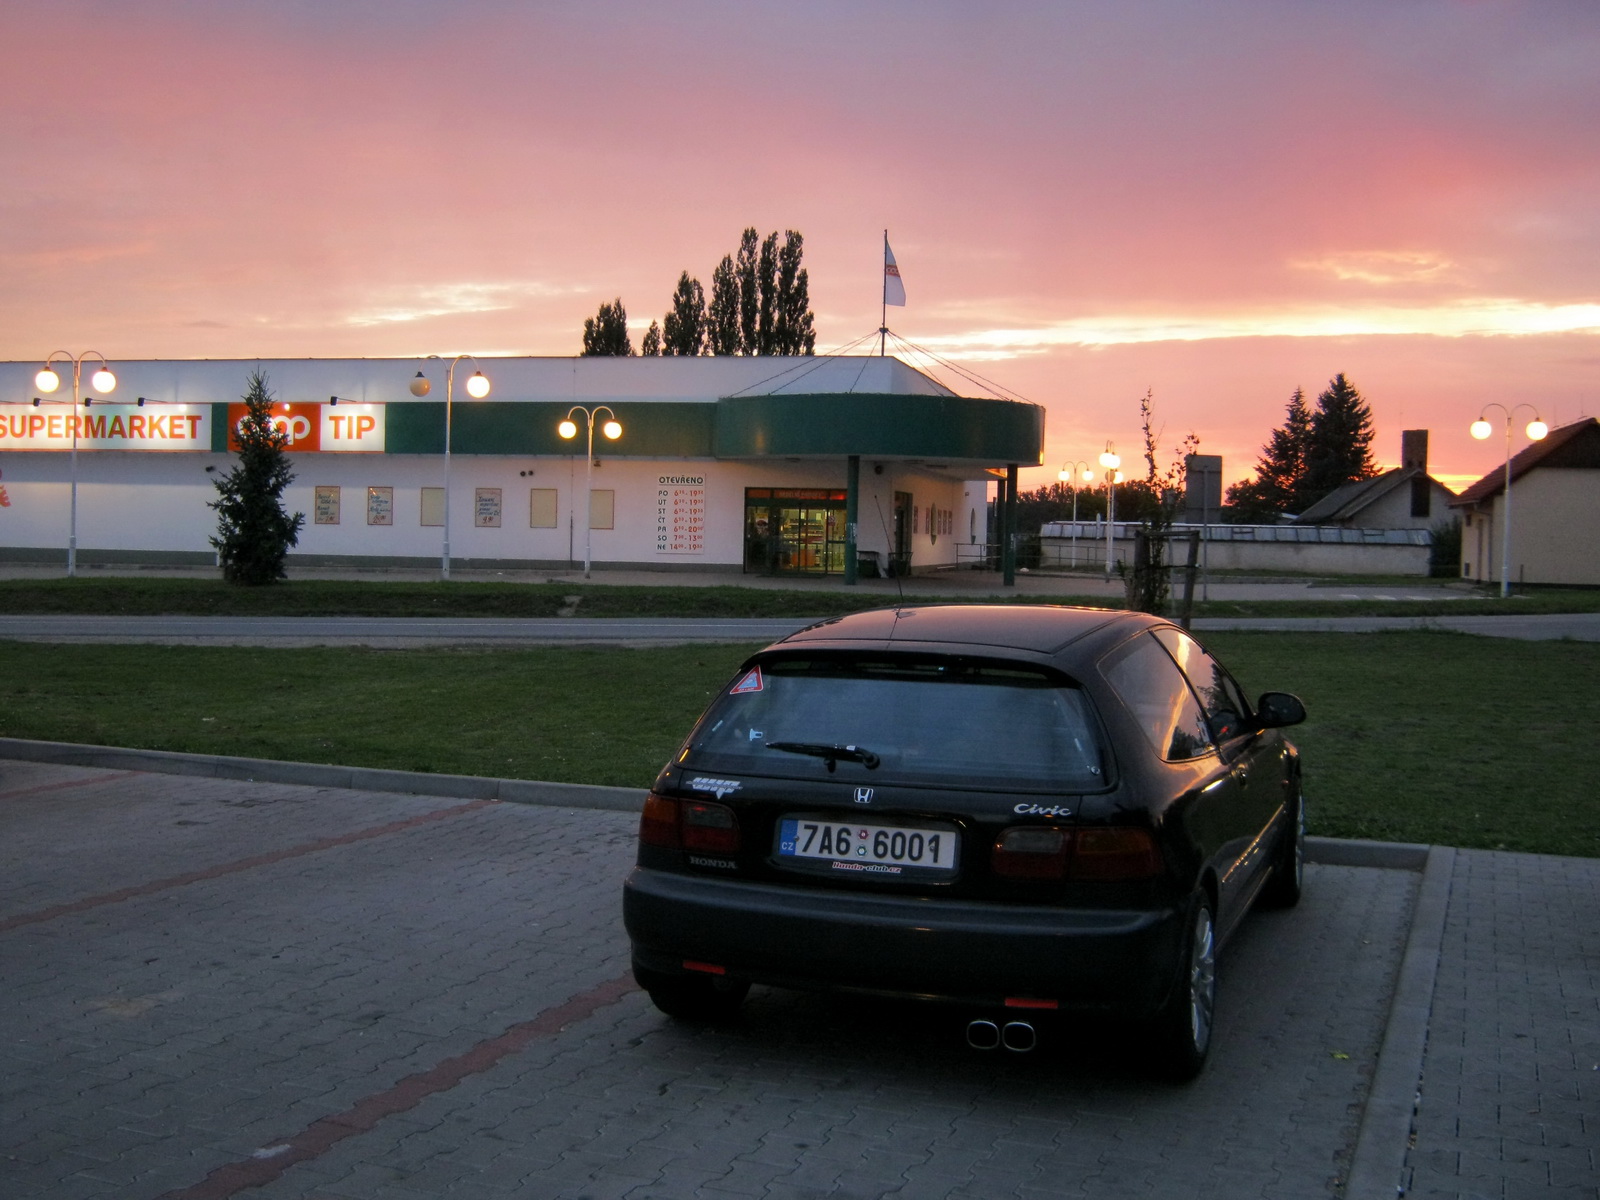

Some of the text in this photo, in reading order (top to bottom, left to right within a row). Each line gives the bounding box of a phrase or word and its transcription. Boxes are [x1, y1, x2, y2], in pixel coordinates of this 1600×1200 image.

[328, 415, 376, 440] TIP
[658, 474, 704, 485] OTEVŘENO
[1013, 803, 1072, 816] Civic
[781, 841, 795, 851] CZ
[801, 824, 941, 864] 7A6 6001
[689, 855, 738, 870] HONDA
